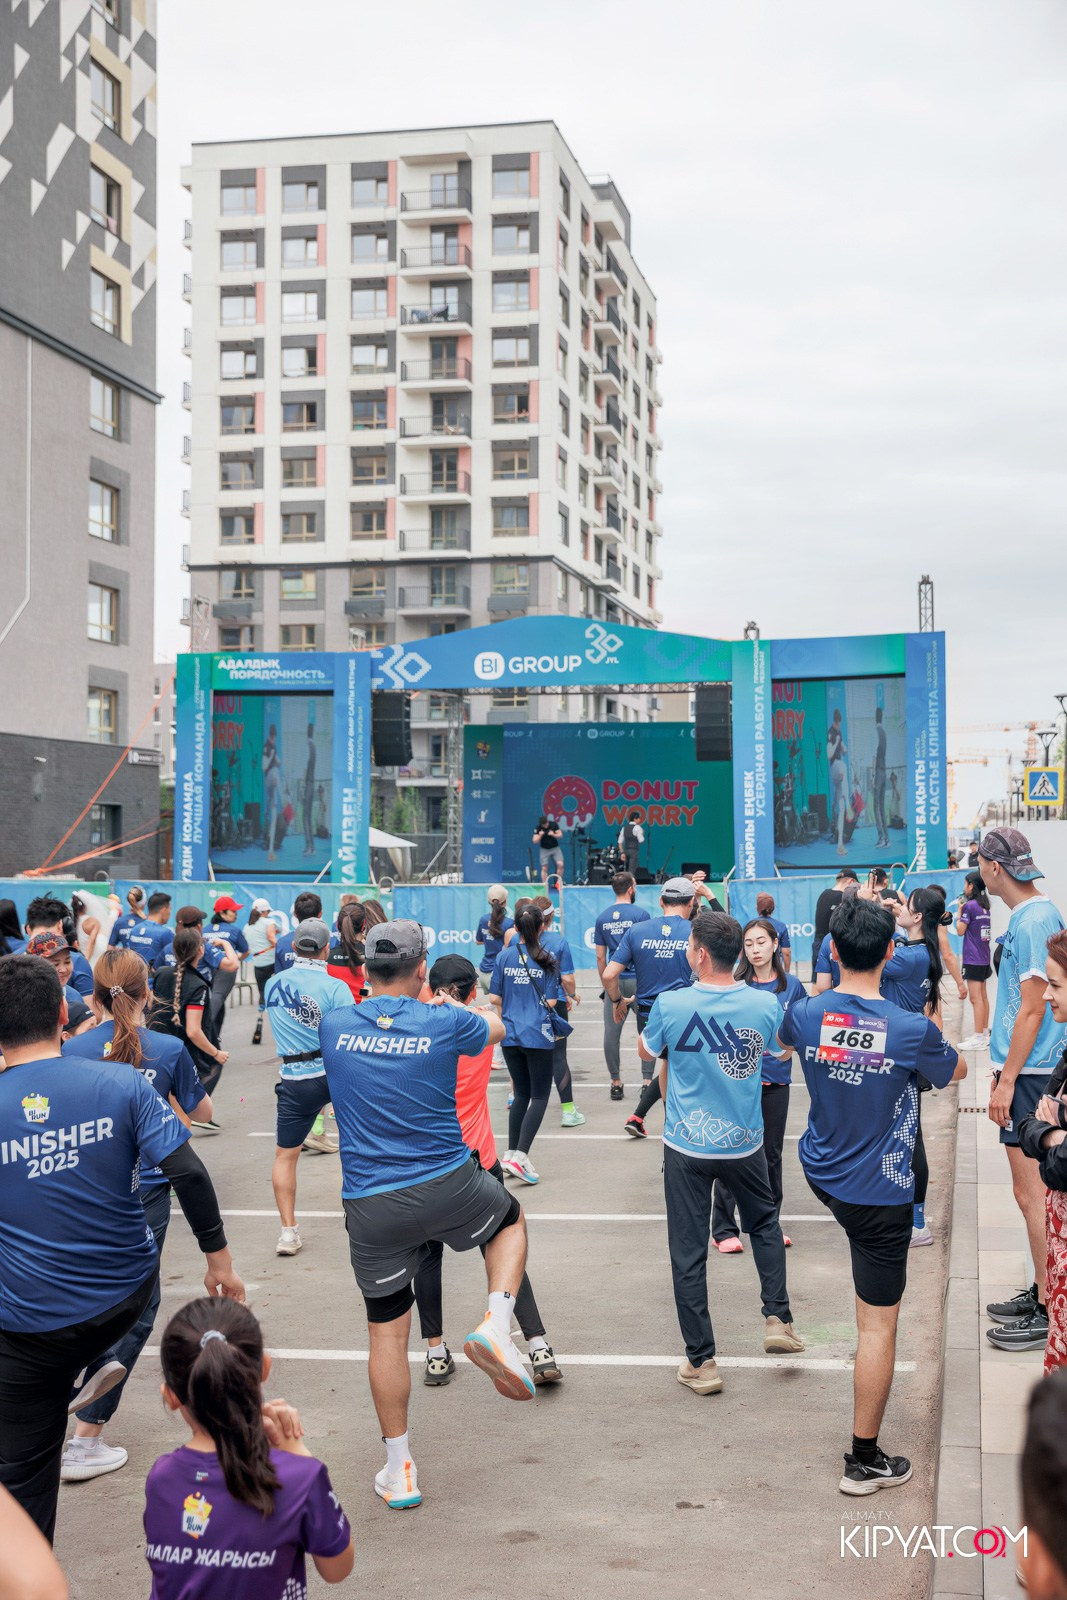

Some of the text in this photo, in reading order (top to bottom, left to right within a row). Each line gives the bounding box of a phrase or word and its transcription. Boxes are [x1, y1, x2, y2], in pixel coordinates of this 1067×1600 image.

[229, 669, 326, 680] ПОРЯДОЧНОСТЬ
[508, 655, 582, 674] GROUP
[599, 730, 625, 738] GROUP
[754, 685, 767, 818] УСЕРДНАЯ РАБОТА
[928, 689, 940, 825] СЧАСТЬЕ КЛИЕНТА
[193, 711, 206, 845] ЛУЧШАЯ КОМАНДА
[602, 780, 699, 801] DONUT
[743, 770, 756, 816] ЕҢБЕК
[915, 760, 928, 825] БАҚЫТЫ
[183, 771, 195, 843] КОМАНДА
[602, 804, 699, 827] WORRY
[602, 920, 634, 931] FINISHER
[610, 928, 624, 936] 2025
[640, 939, 689, 951] FINISHER
[654, 950, 675, 959] 2025
[513, 976, 530, 985] 2025
[335, 1033, 432, 1055] FINISHER
[831, 1029, 875, 1050] 468
[827, 1067, 864, 1086] 2025
[28, 1109, 36, 1117] BI
[31, 1112, 47, 1122] RUN
[1, 1116, 114, 1166] INISHER
[26, 1149, 80, 1180] 2025
[187, 1522, 203, 1533] RUN
[194, 1548, 277, 1569] ЖАРЫСЫ
